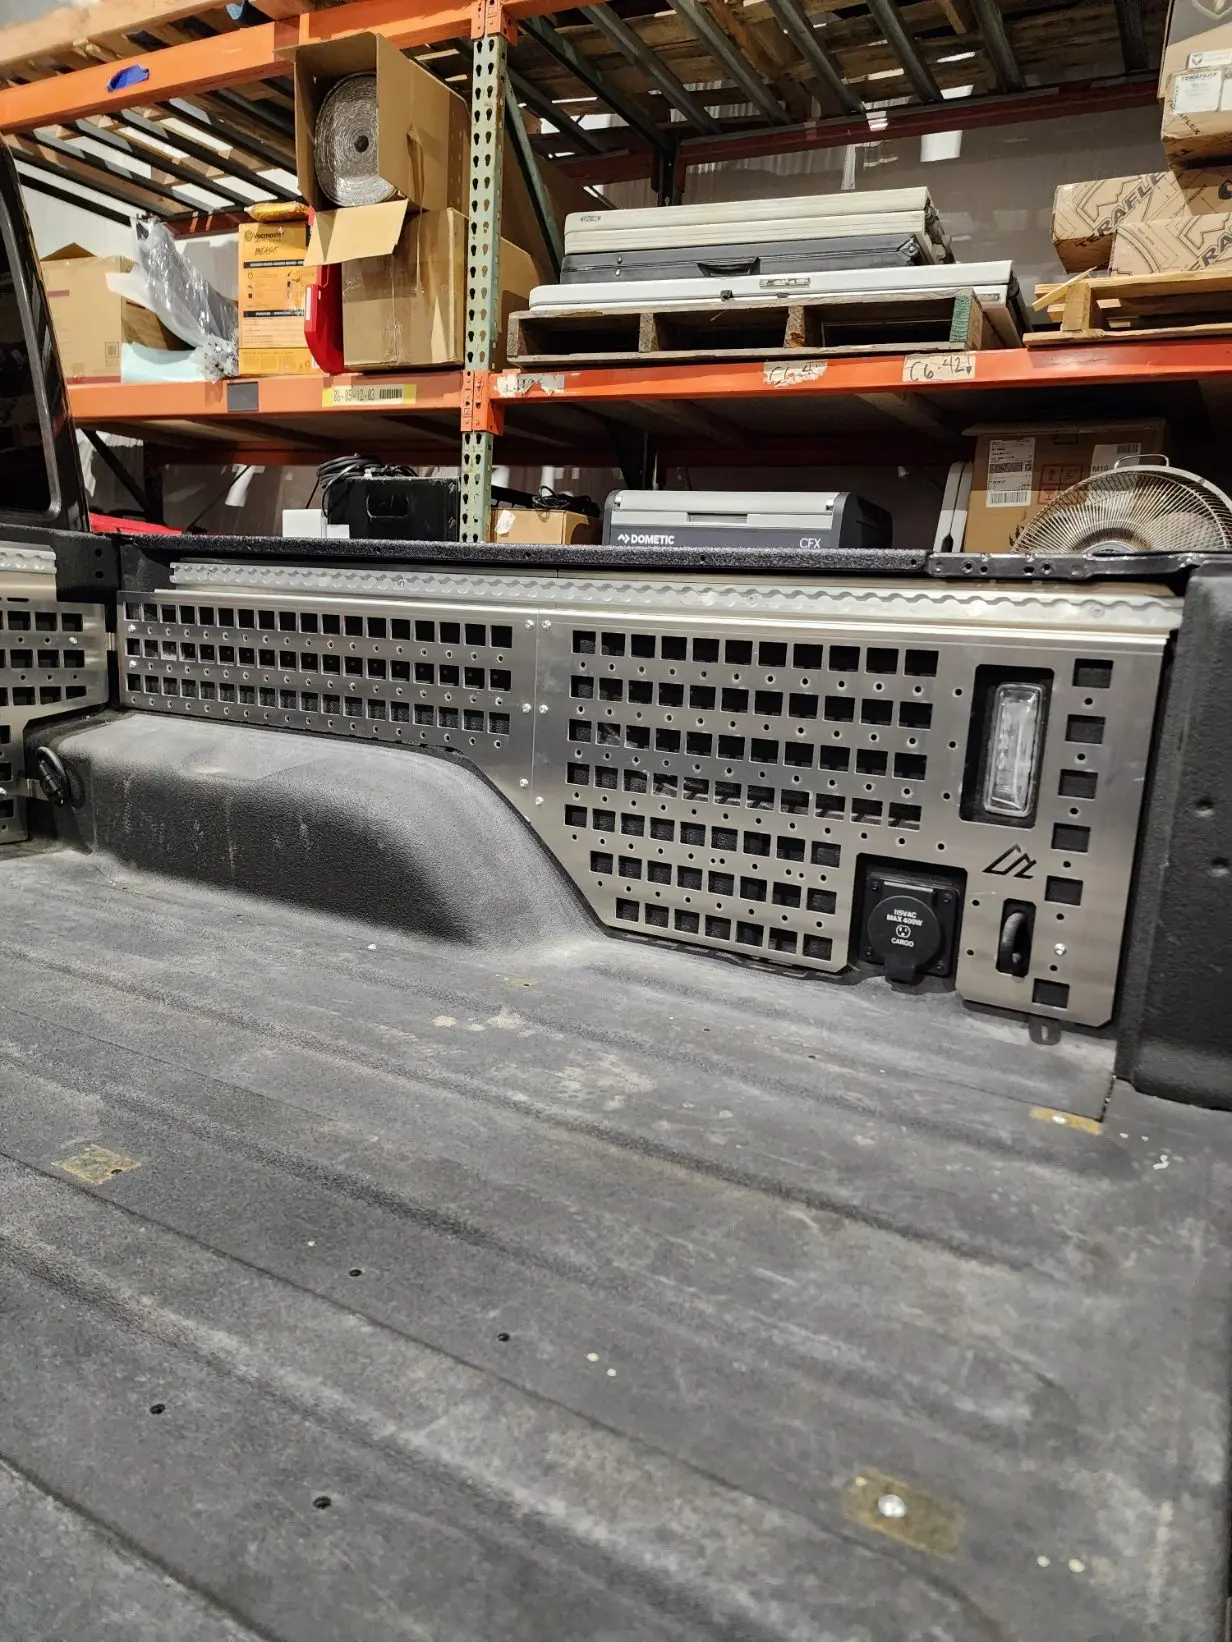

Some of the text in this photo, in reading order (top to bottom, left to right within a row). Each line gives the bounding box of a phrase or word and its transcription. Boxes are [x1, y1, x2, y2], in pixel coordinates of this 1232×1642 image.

[630, 534, 675, 546] DOMETIC
[799, 537, 821, 550] CFX
[894, 909, 917, 918] 115VAC
[886, 914, 923, 926] MAX 400W
[891, 937, 914, 947] CARGO
